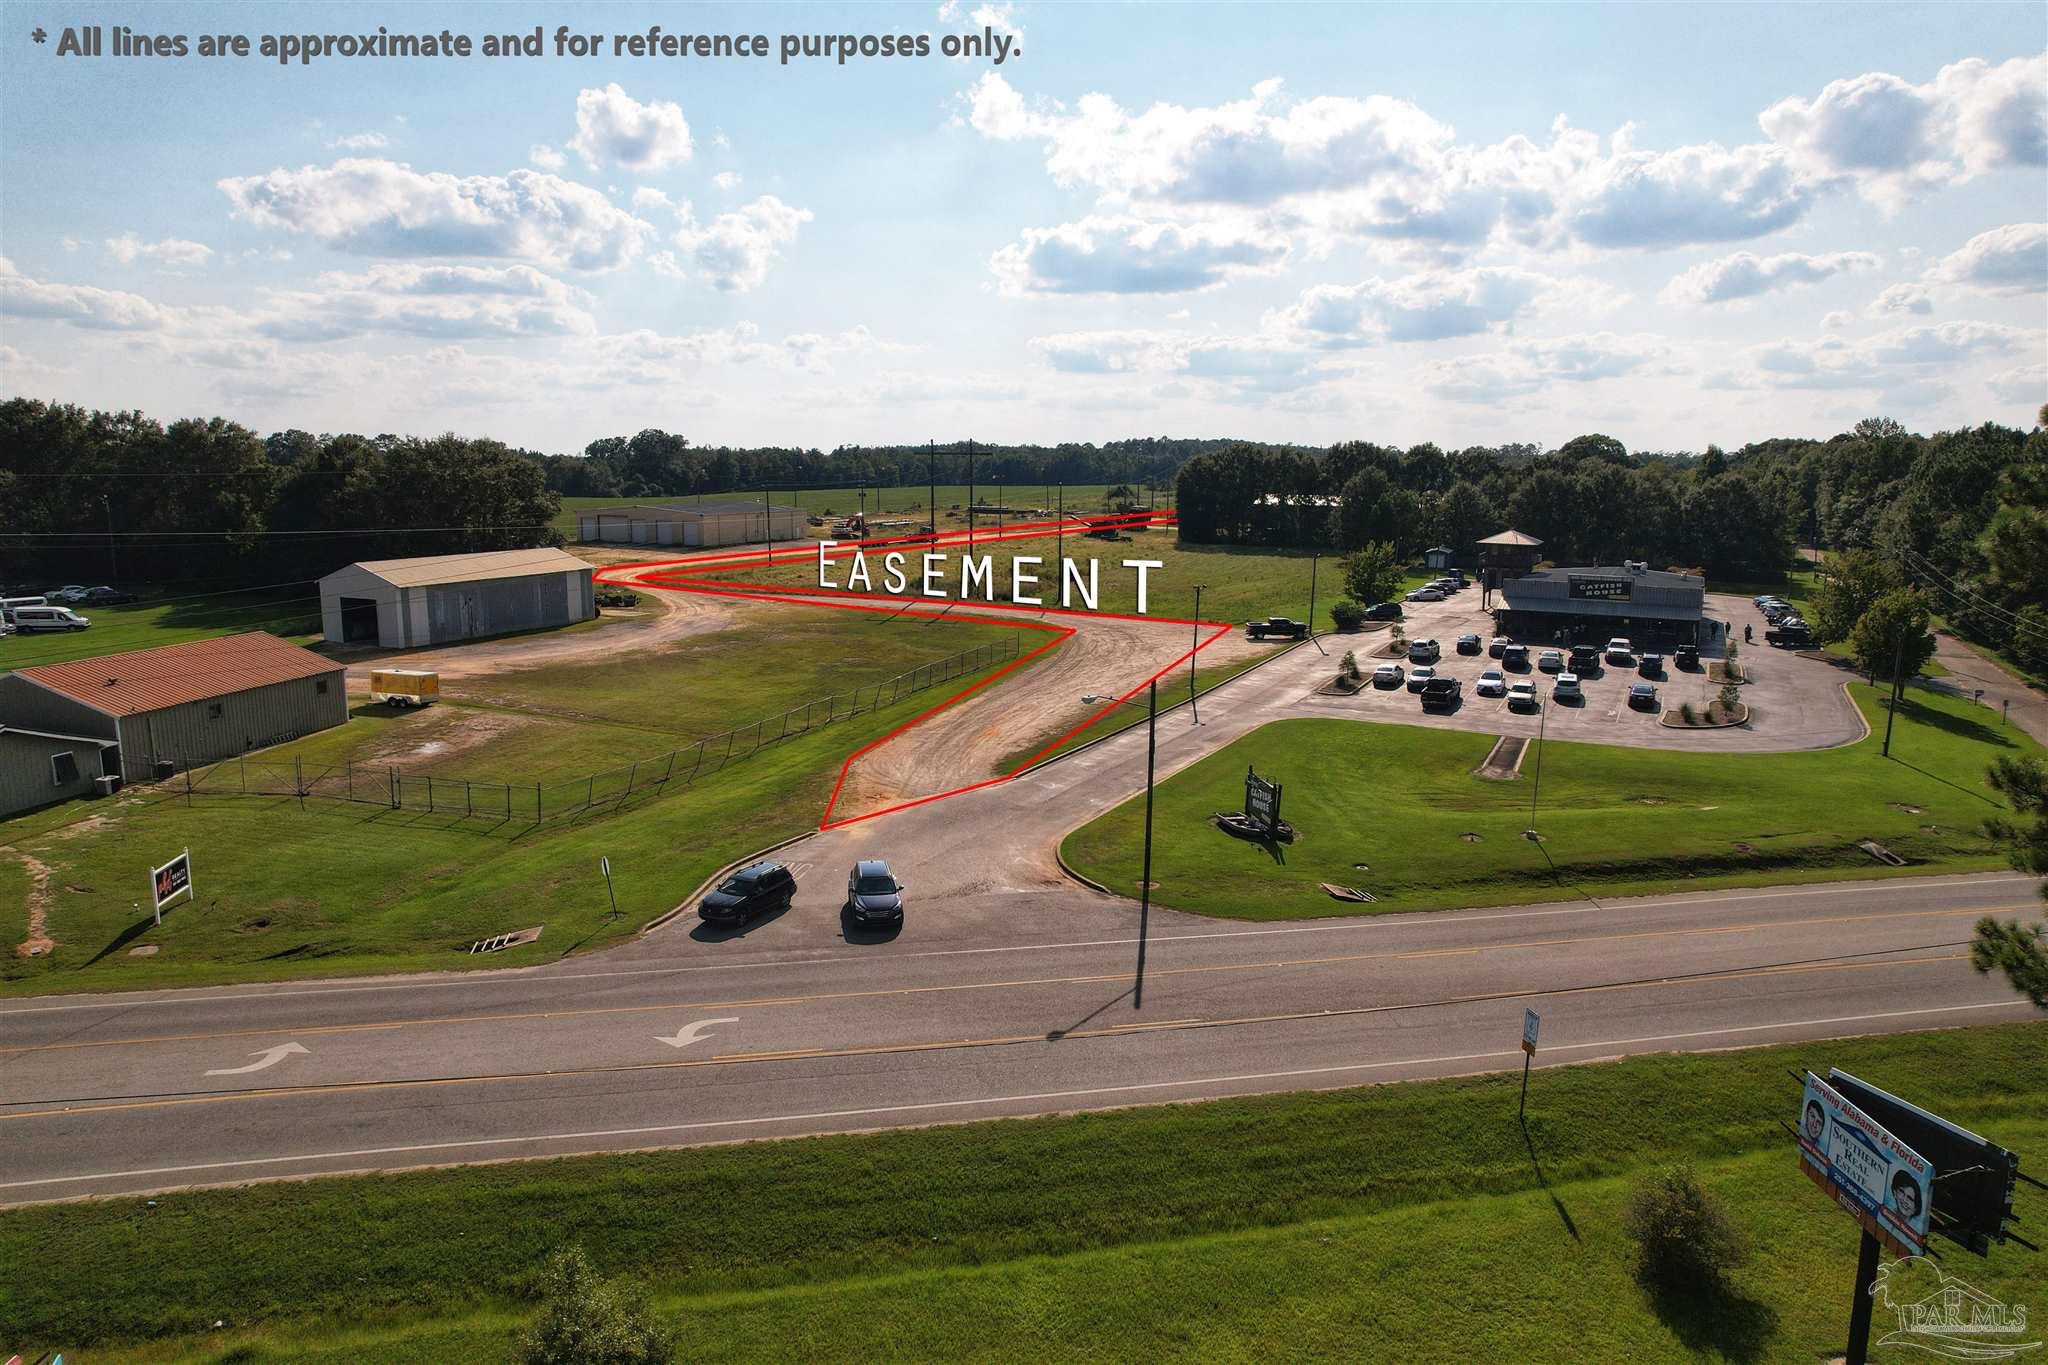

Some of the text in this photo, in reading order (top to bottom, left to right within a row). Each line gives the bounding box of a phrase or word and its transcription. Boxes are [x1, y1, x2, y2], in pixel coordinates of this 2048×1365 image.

[1579, 582, 1623, 591] CATFISH
[1585, 588, 1622, 596] HOUSE
[1809, 1078, 1925, 1174] Serving Alabama & Florida
[1832, 1124, 1885, 1175] SOUTHERN
[1844, 1148, 1870, 1177] REAL
